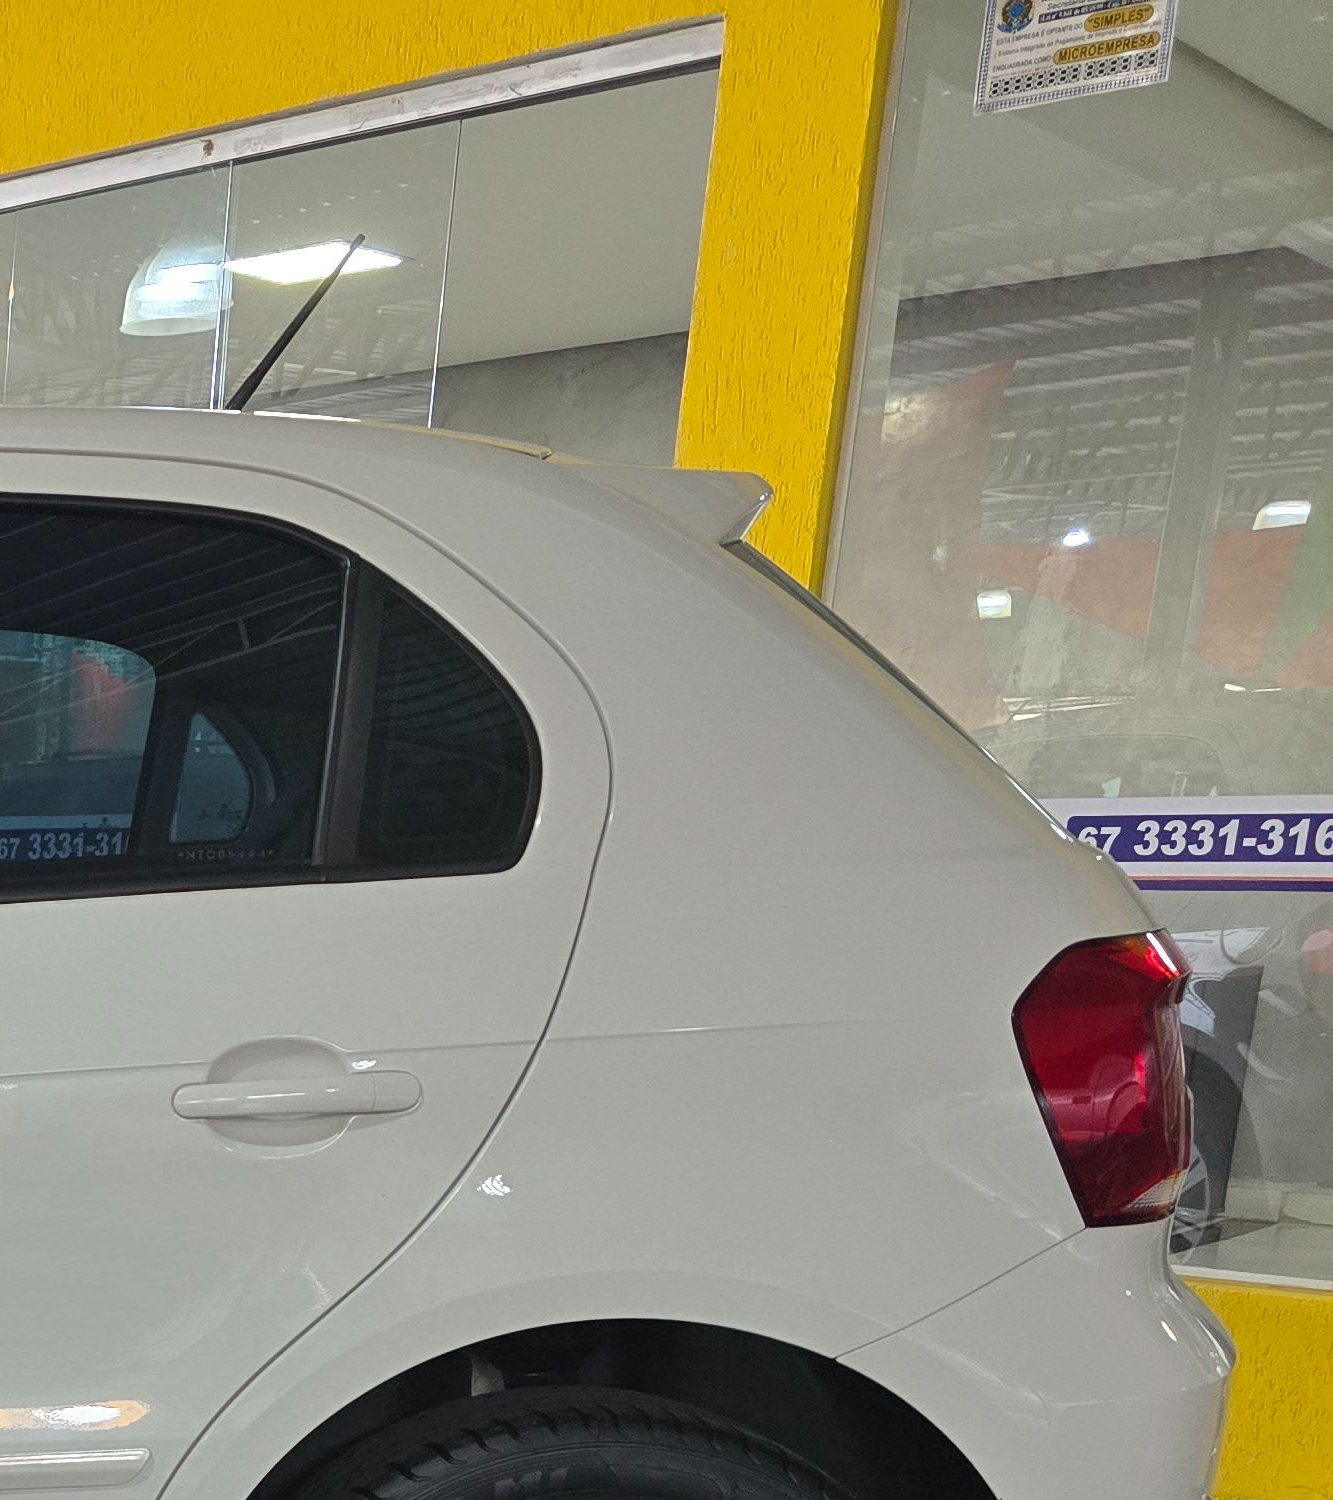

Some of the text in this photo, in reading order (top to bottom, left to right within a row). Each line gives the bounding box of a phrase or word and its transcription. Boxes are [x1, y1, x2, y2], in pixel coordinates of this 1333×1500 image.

[1012, 31, 1039, 44] EMPRESA
[1046, 24, 1072, 36] OPTANTE
[1034, 54, 1052, 65] COMO
[1058, 35, 1154, 61] MICROEMPRESA
[1133, 818, 1333, 857] 3331-316
